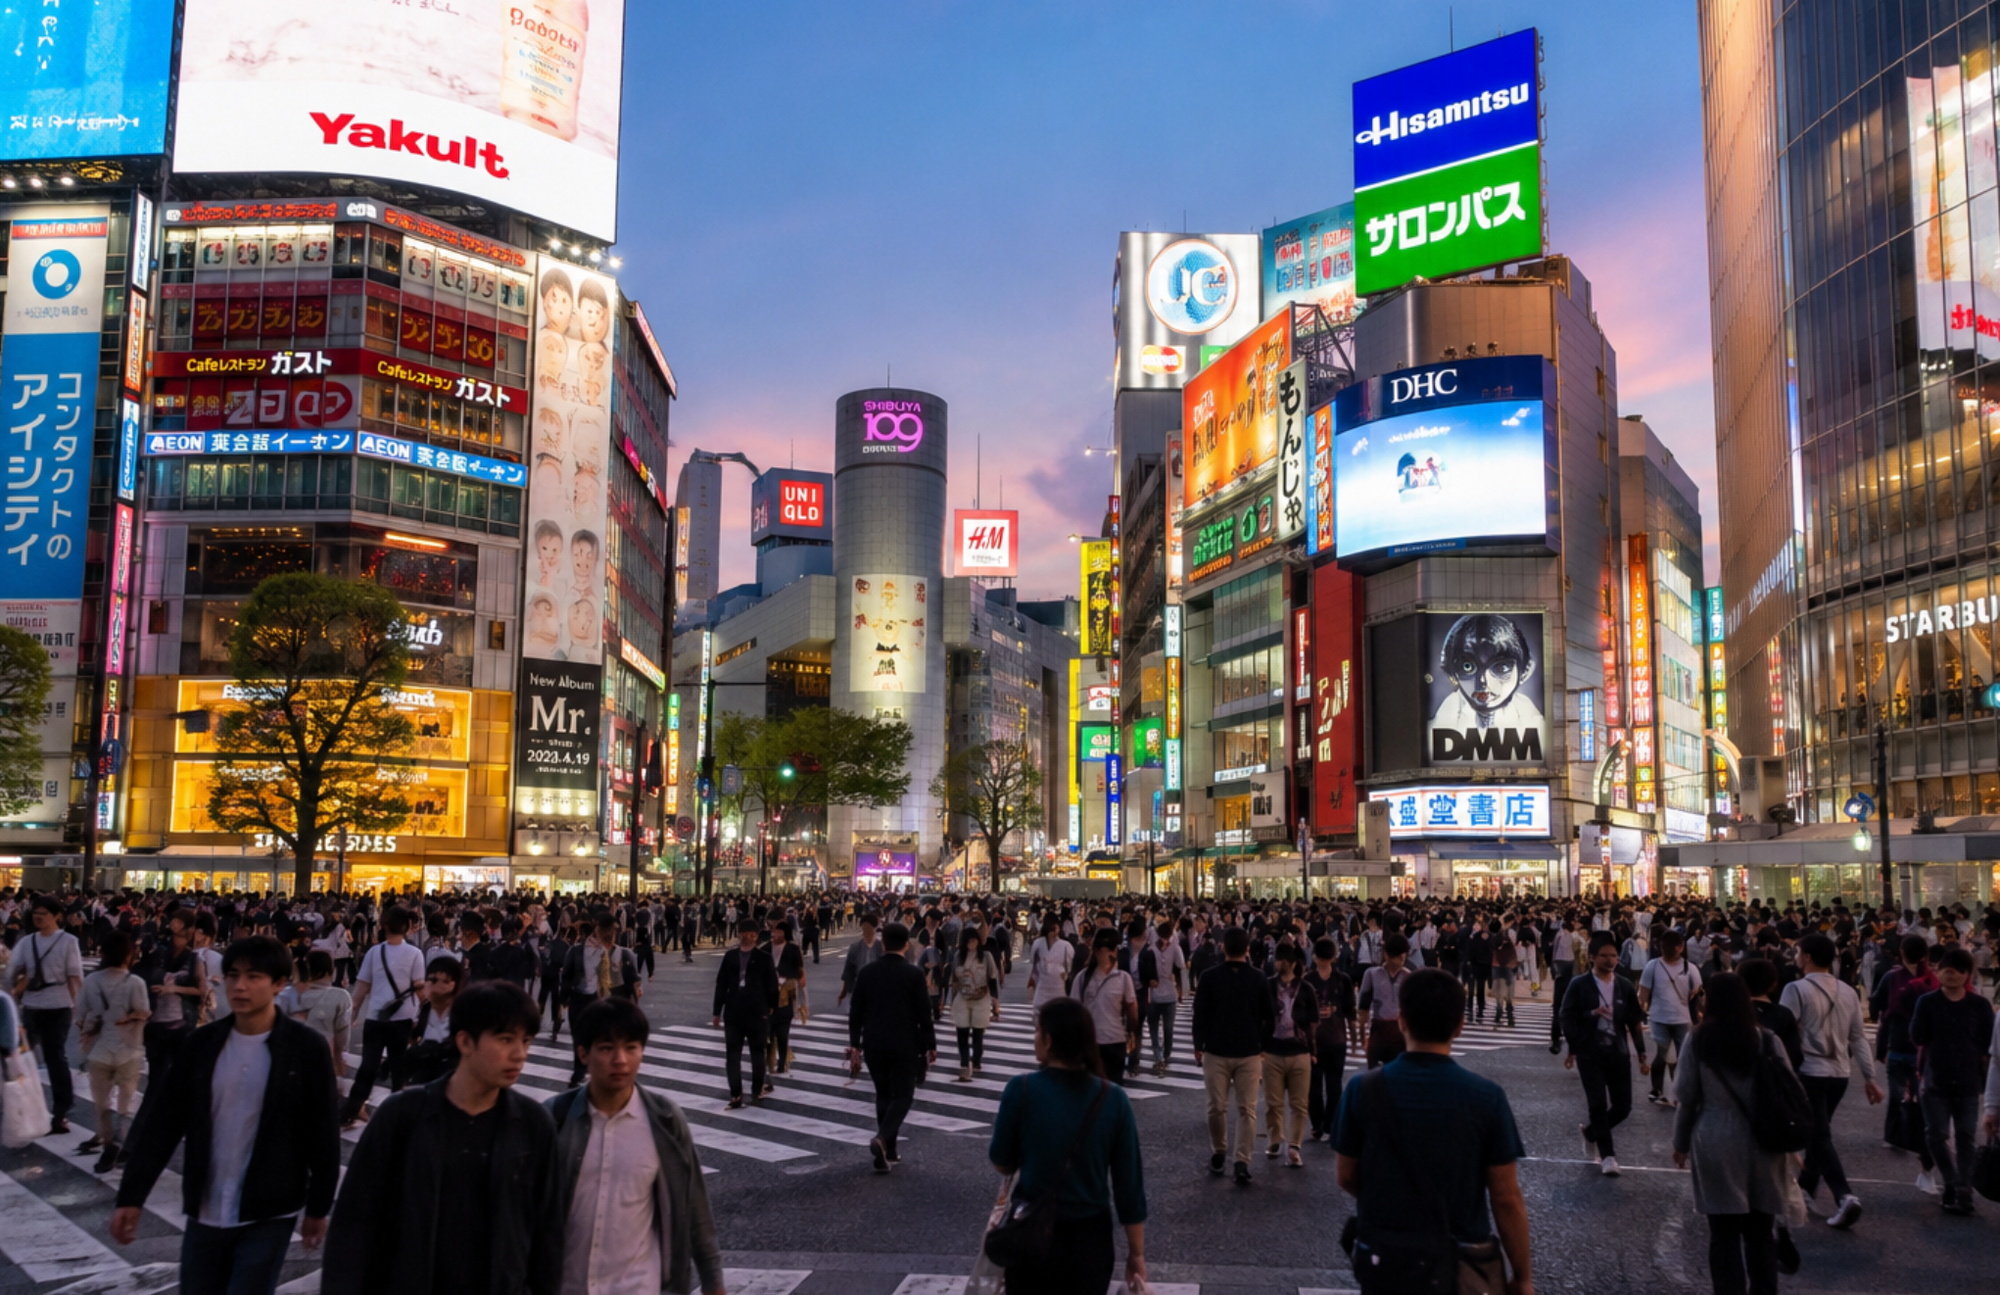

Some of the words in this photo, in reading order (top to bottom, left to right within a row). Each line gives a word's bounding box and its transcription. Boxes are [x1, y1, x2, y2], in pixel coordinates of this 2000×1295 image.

[1355, 83, 1529, 146] Hisamitsu
[309, 111, 510, 179] Yakult
[1365, 181, 1526, 257] サロンパス
[271, 350, 332, 375] ガスト
[455, 377, 511, 408] ガスト
[1390, 368, 1458, 404] DHC
[150, 436, 202, 451] AEON
[361, 436, 410, 460] AEON
[863, 412, 924, 453] 109
[47, 373, 81, 560] コンタクトの
[785, 486, 816, 503] UNI
[529, 672, 556, 687] New
[558, 675, 595, 691] Album
[1432, 727, 1543, 761] DMM
